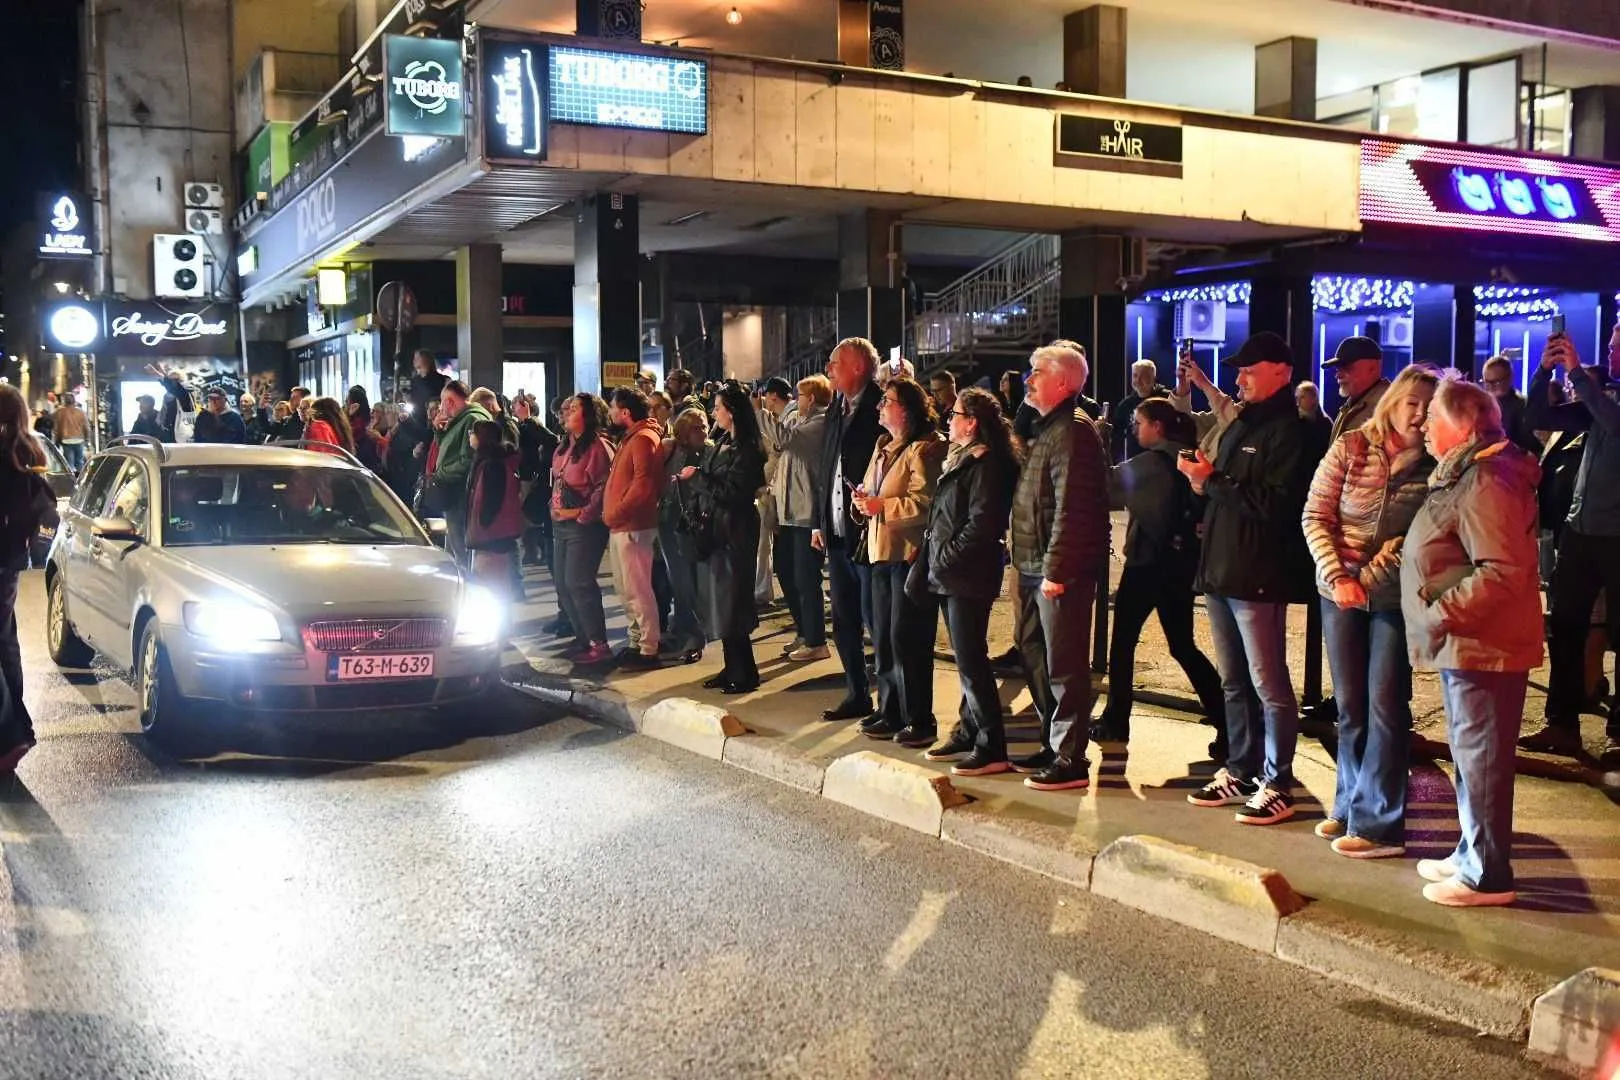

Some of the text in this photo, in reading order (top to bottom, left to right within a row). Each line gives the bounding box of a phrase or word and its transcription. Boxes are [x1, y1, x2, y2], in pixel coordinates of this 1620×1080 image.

[556, 53, 669, 93] TUBORG
[392, 76, 461, 100] TUBORG
[1106, 125, 1144, 157] HAIR
[342, 656, 431, 675] T63-M-639
